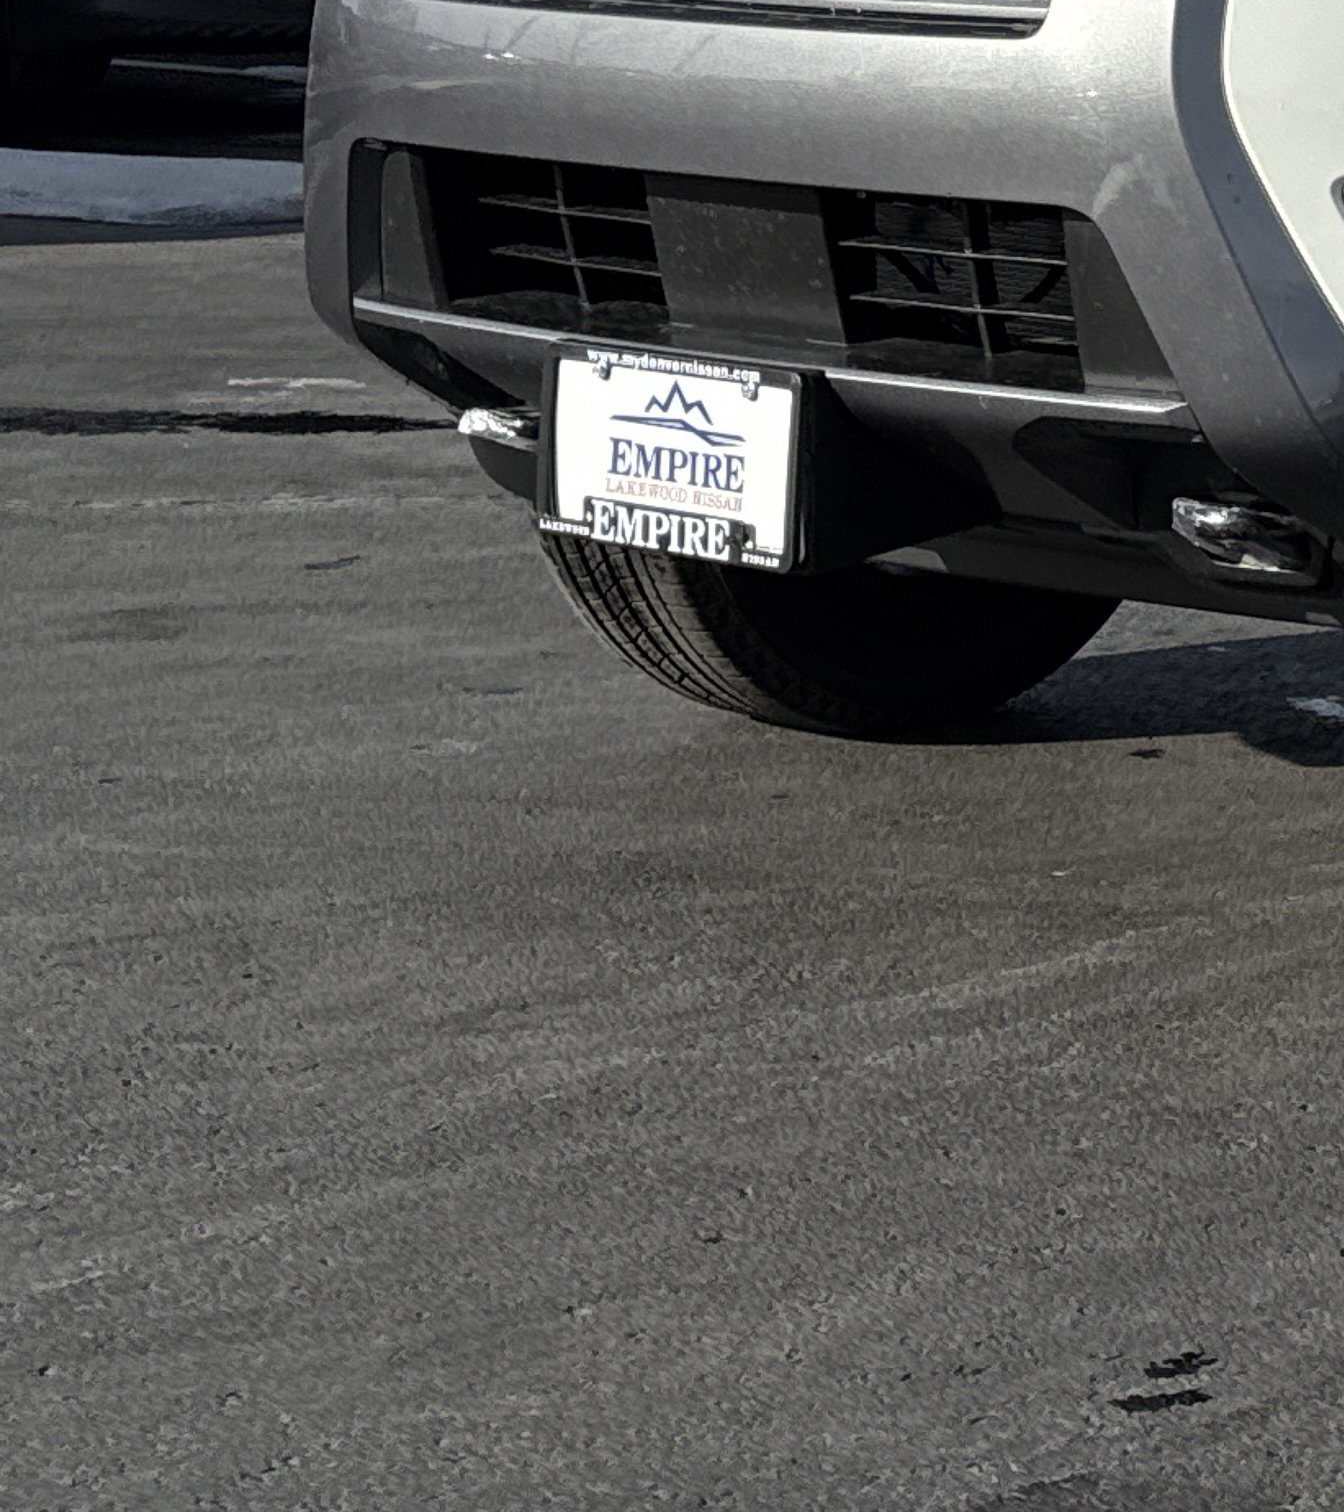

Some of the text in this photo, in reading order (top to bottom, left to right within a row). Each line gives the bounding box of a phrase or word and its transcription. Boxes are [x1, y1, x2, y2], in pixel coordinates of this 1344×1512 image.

[608, 437, 745, 493] EMPIRE
[605, 478, 743, 512] LAKEWOOD NISSAN
[590, 499, 732, 562] EMPIRE
